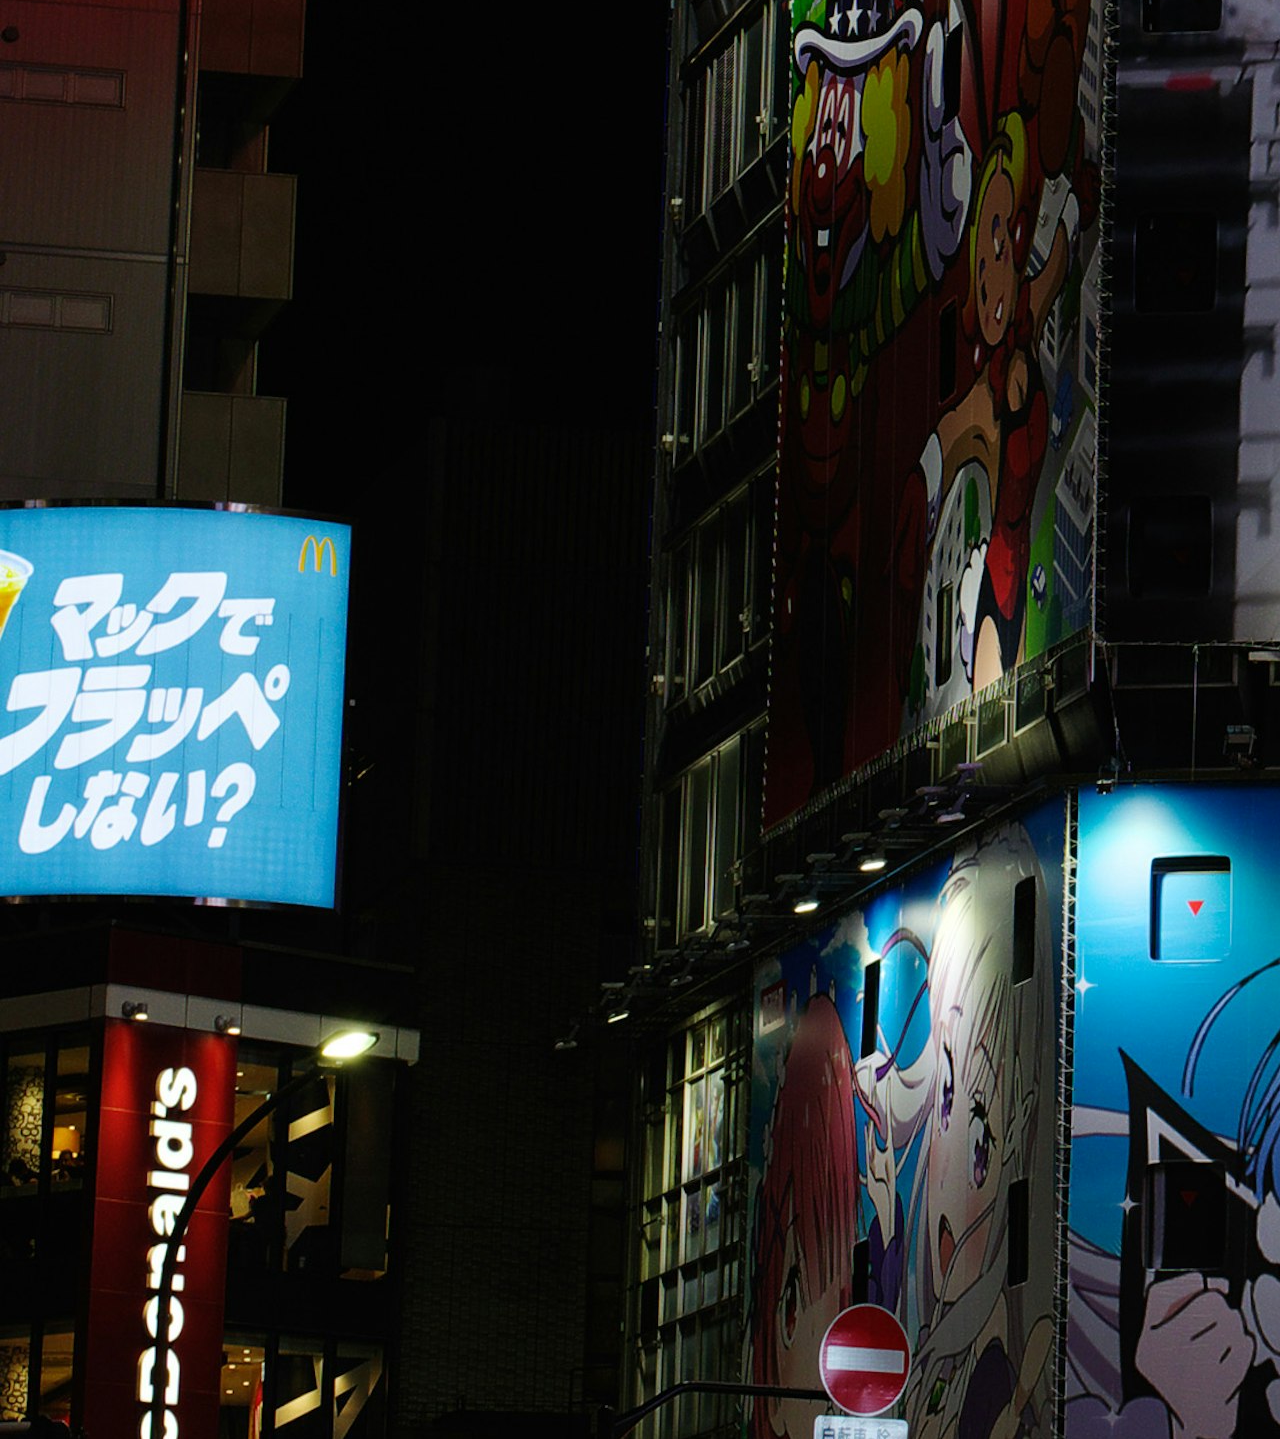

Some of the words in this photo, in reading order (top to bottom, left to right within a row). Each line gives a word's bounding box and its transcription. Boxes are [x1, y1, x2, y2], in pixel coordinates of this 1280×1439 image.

[50, 571, 276, 662] マックで
[0, 664, 291, 777] フラッペ
